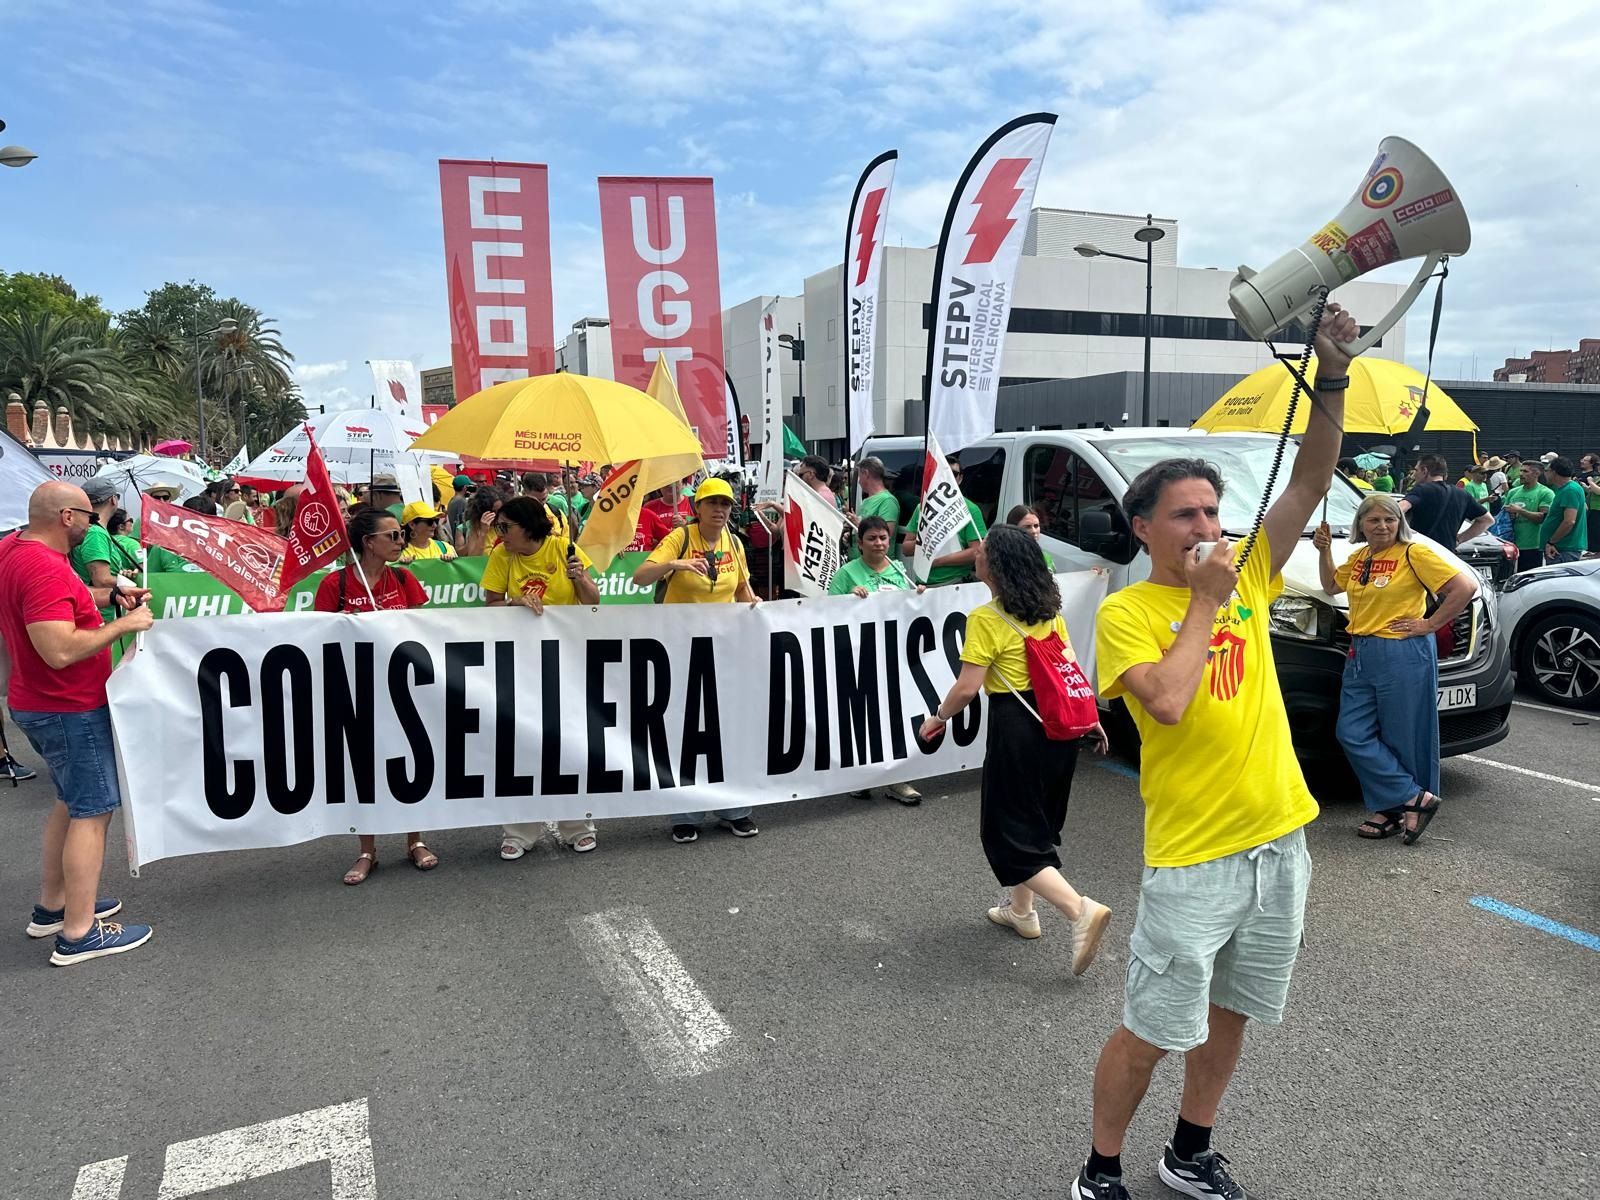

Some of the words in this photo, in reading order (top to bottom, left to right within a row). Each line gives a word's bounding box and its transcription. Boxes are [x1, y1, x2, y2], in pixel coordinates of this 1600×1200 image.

[1395, 198, 1434, 219] CCOO
[629, 196, 693, 388] UGT
[851, 297, 861, 392] STEPV
[865, 295, 873, 376] VALENCIANA
[941, 276, 976, 389] STEPV
[969, 279, 994, 390] INTERSINDICAL
[982, 281, 1006, 374] VALENCIANA
[514, 439, 582, 452] EDUCACIÓ
[515, 429, 537, 439] MÉS
[543, 432, 582, 440] MILLOR
[269, 455, 303, 463] STEPV
[150, 511, 234, 549] UGT
[226, 556, 277, 598] Valencià
[348, 597, 367, 606] UGT
[1449, 688, 1472, 706] LDX
[197, 636, 725, 820] CONSELLERA
